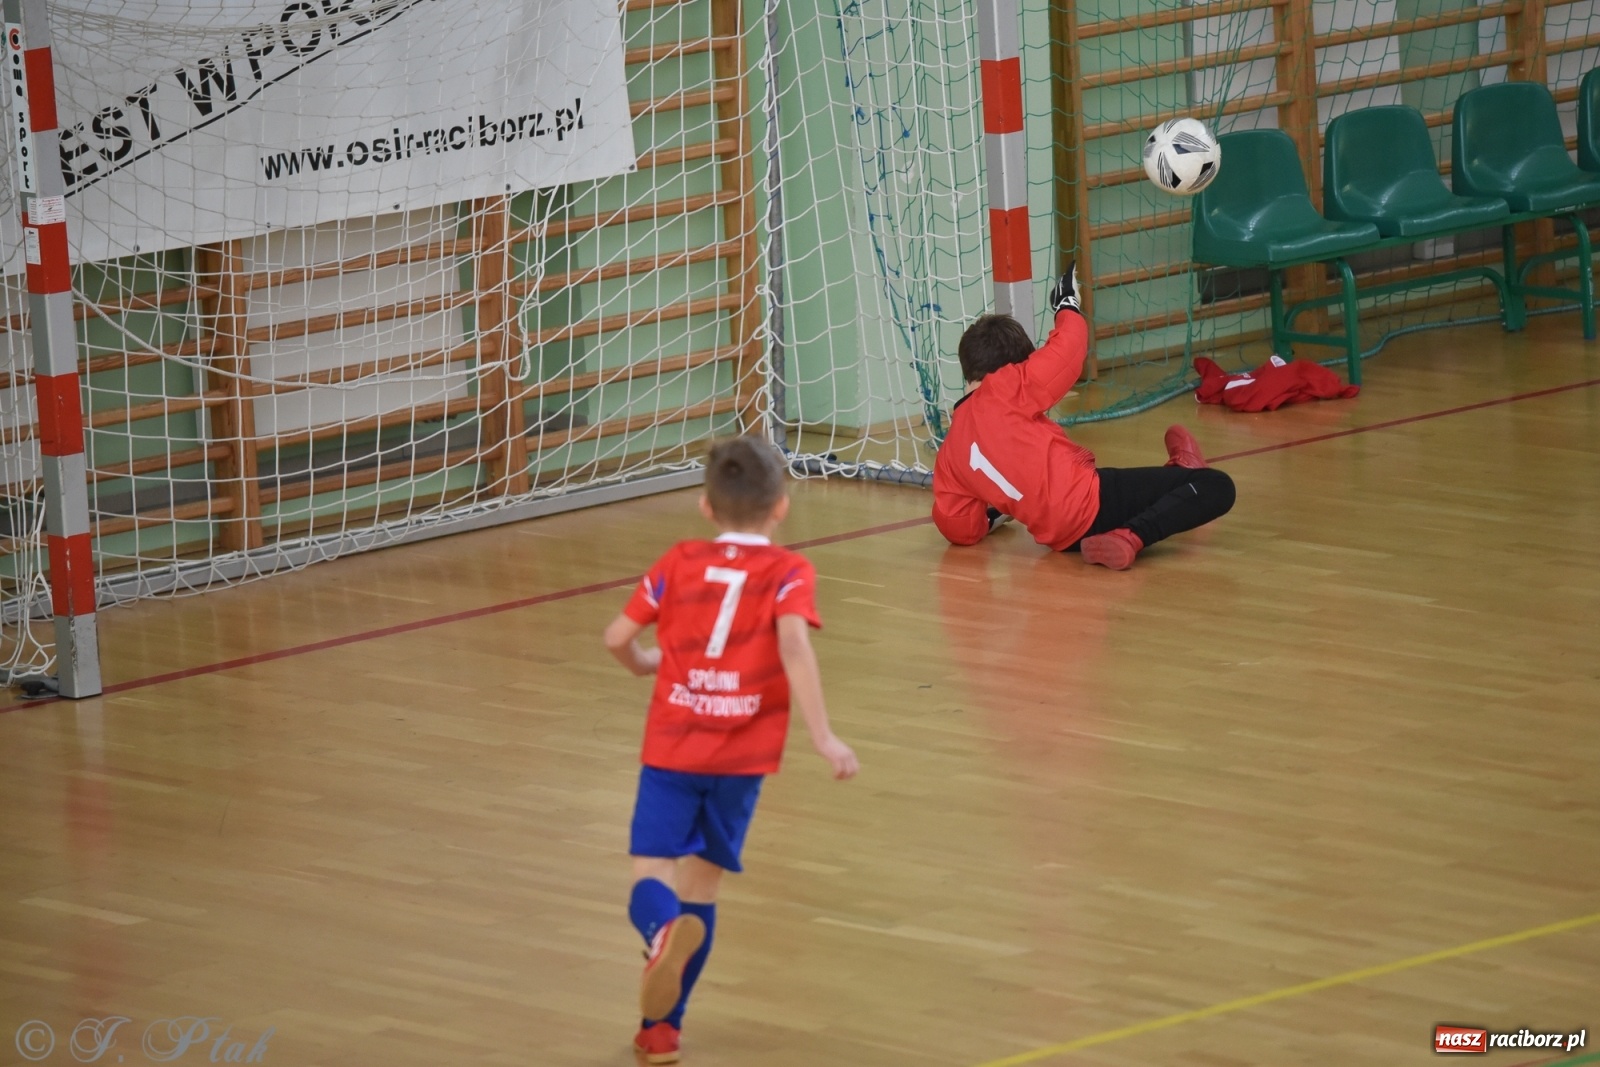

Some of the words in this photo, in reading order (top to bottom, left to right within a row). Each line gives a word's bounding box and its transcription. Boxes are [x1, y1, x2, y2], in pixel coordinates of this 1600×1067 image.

[260, 97, 584, 180] www.osir-raciborz.pl
[970, 441, 1024, 501] 1
[704, 566, 748, 659] 7
